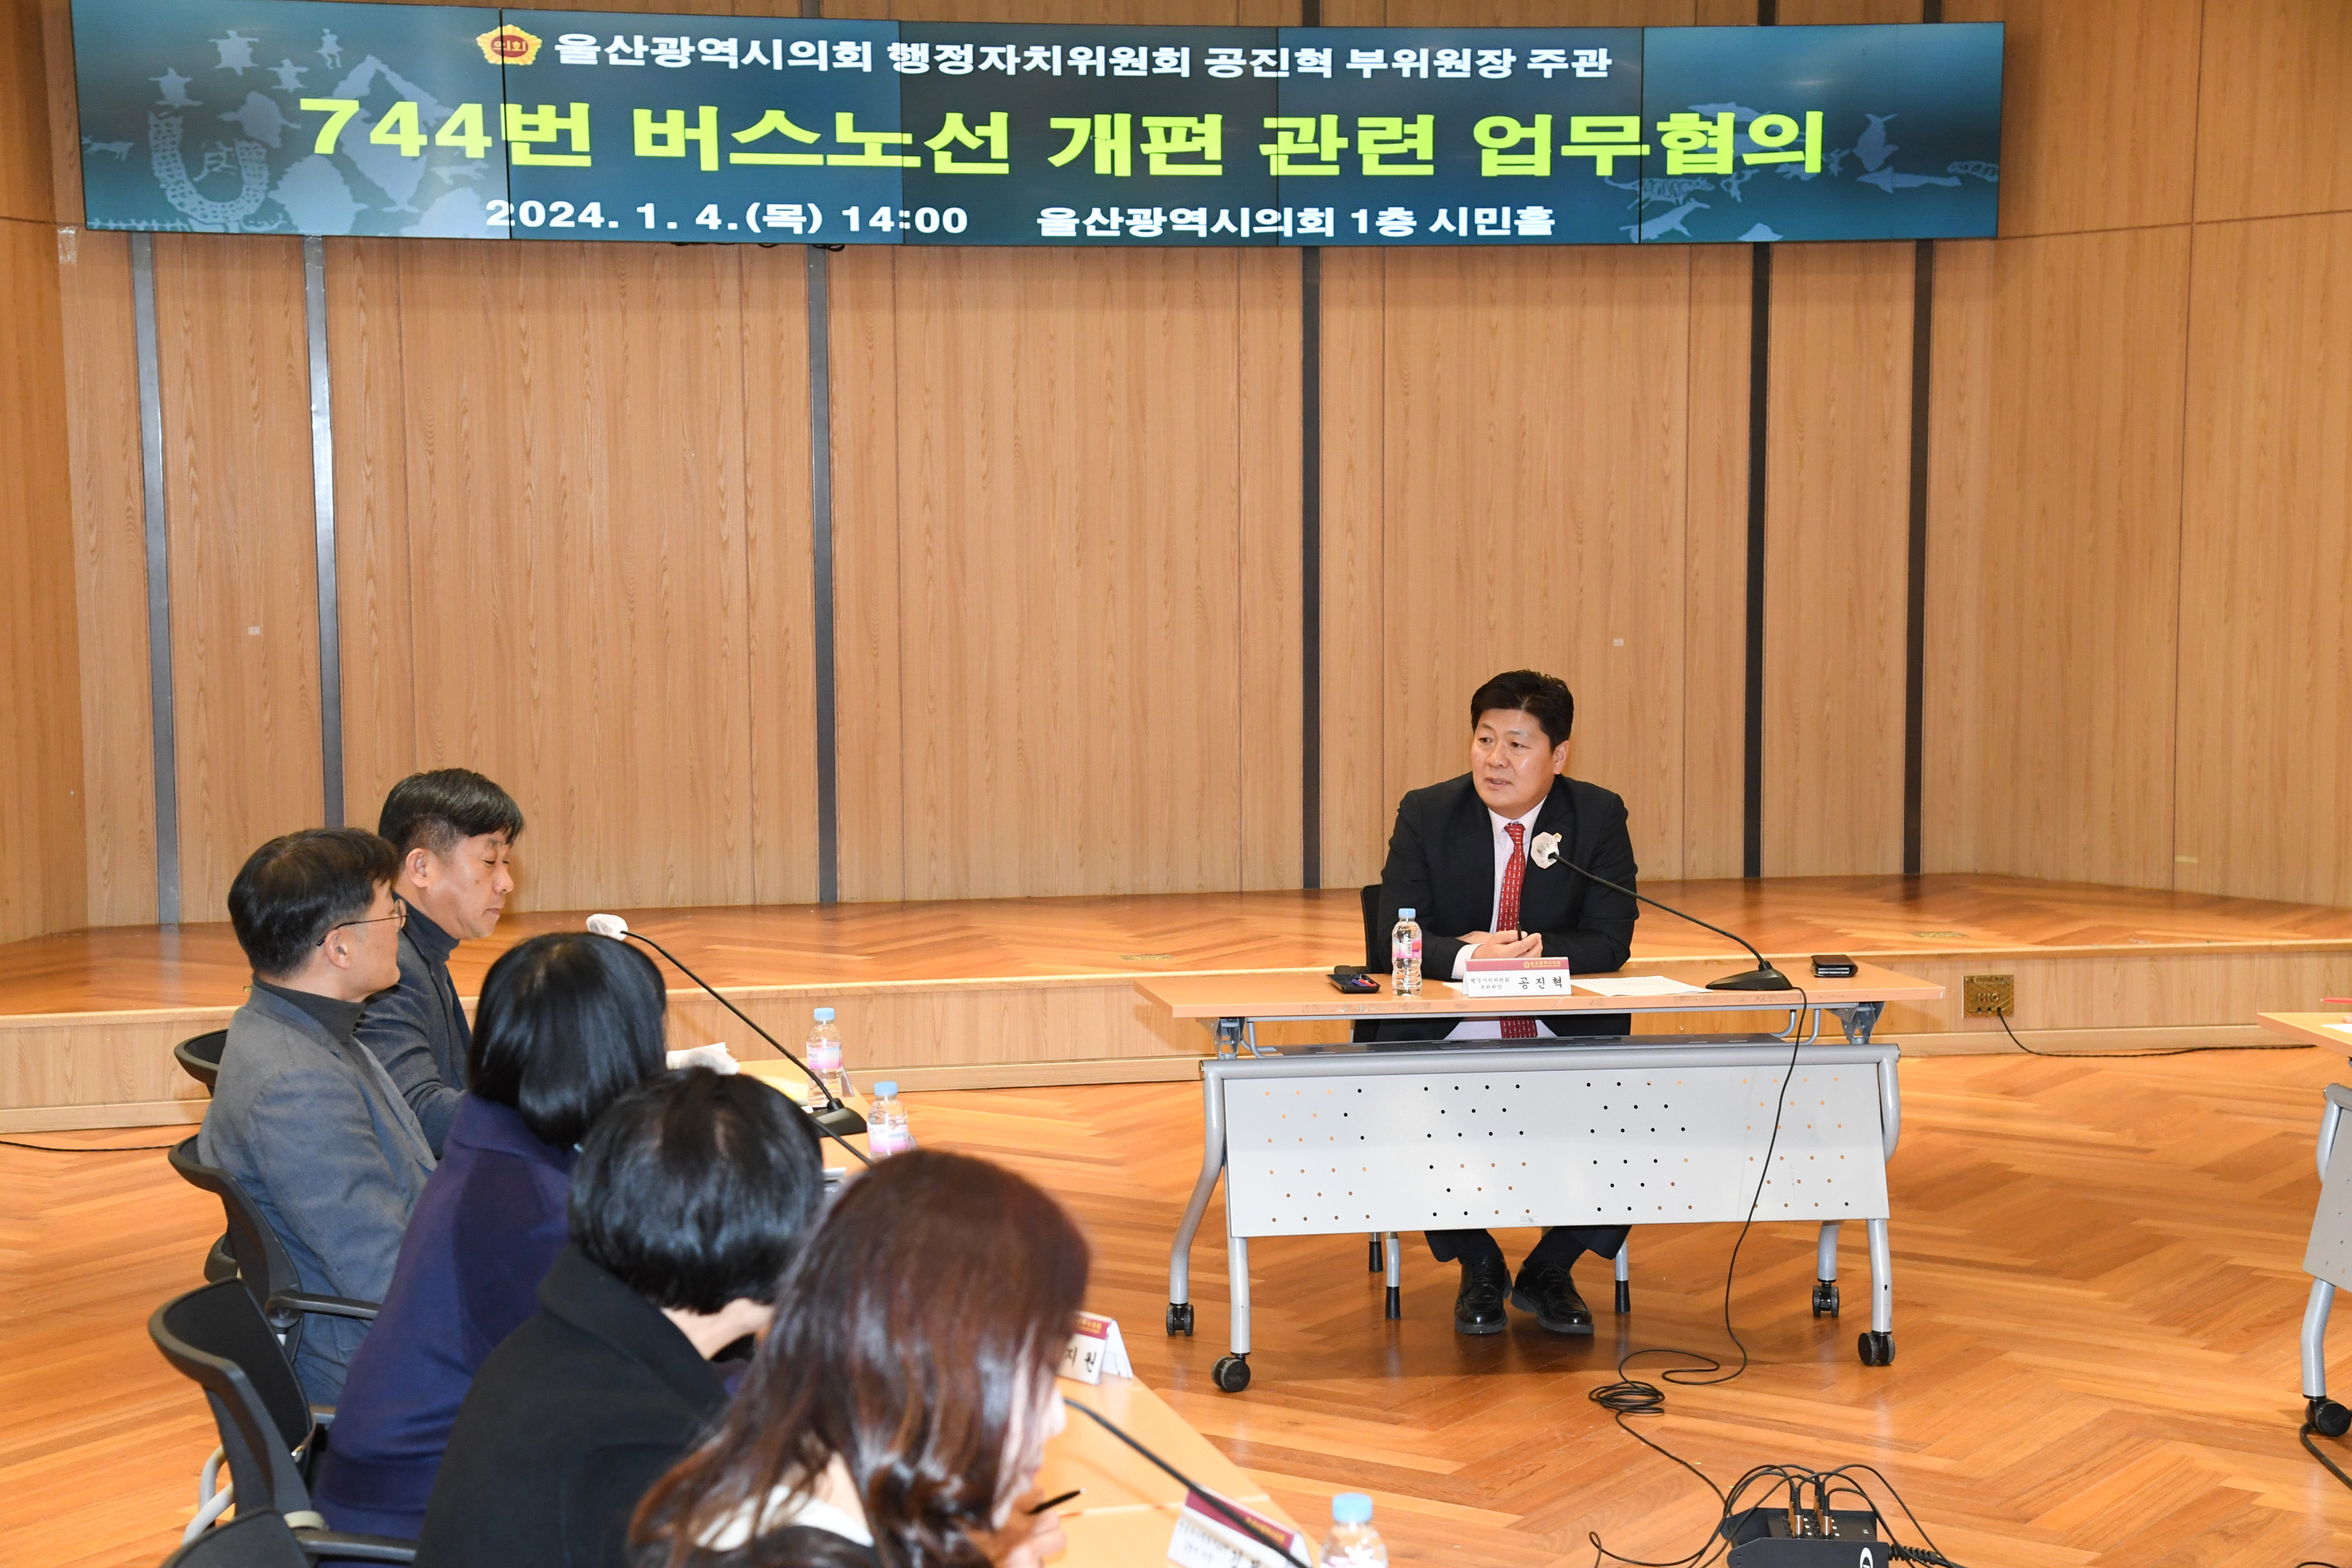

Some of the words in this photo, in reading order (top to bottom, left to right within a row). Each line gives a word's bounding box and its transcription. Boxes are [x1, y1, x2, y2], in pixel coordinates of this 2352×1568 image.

[492, 41, 526, 52] 의회
[555, 34, 872, 71] 울산광역시의회
[887, 42, 1190, 77] 행정자치위원회
[1205, 47, 1333, 78] 공진혁
[1345, 48, 1517, 79] 부위원장
[1527, 48, 1612, 78] 주관
[299, 99, 592, 166] 744번
[633, 106, 1010, 175] 버스노선
[1048, 113, 1222, 176] 개편
[1259, 114, 1435, 176] 관련
[1473, 111, 1824, 176] 업무협의
[486, 200, 619, 230] 2024.
[637, 203, 677, 230] 1.
[842, 205, 967, 234] 14:00
[1036, 207, 1334, 237] 울산광역시의회
[1351, 207, 1417, 237] 1층
[1428, 206, 1555, 237] 시민홀
